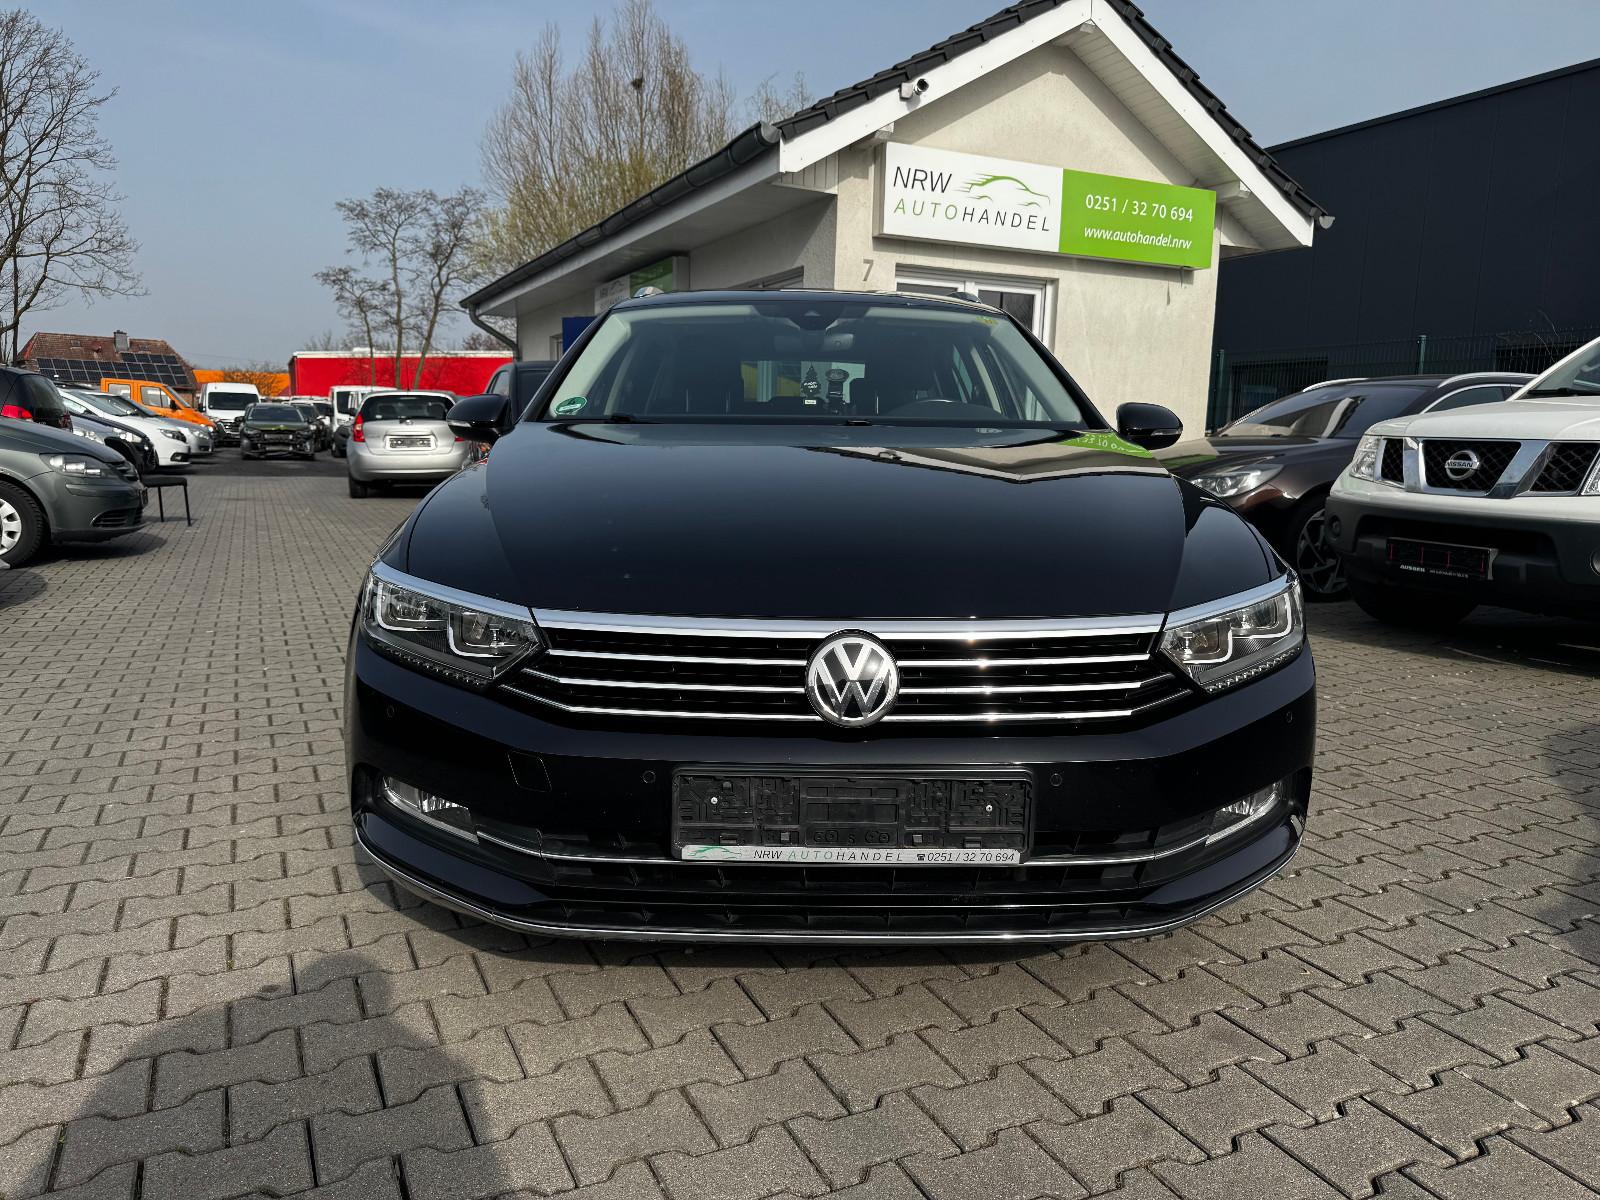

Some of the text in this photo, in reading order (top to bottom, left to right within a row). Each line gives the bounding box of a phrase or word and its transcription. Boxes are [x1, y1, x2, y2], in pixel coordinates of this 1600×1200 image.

[893, 166, 953, 194] NRW
[893, 198, 1050, 232] AUTOHANDEL
[1085, 194, 1193, 222] 0251 / 32 70 694
[1083, 226, 1193, 249] www.autohandel.nrw
[862, 258, 874, 282] 7
[1446, 460, 1474, 468] NISSAN
[753, 850, 783, 860] NRW
[787, 850, 905, 862] AUTOHANDEL
[927, 852, 953, 862] 0251
[962, 852, 977, 862] 32
[980, 852, 993, 862] 70
[995, 852, 1015, 862] 694
